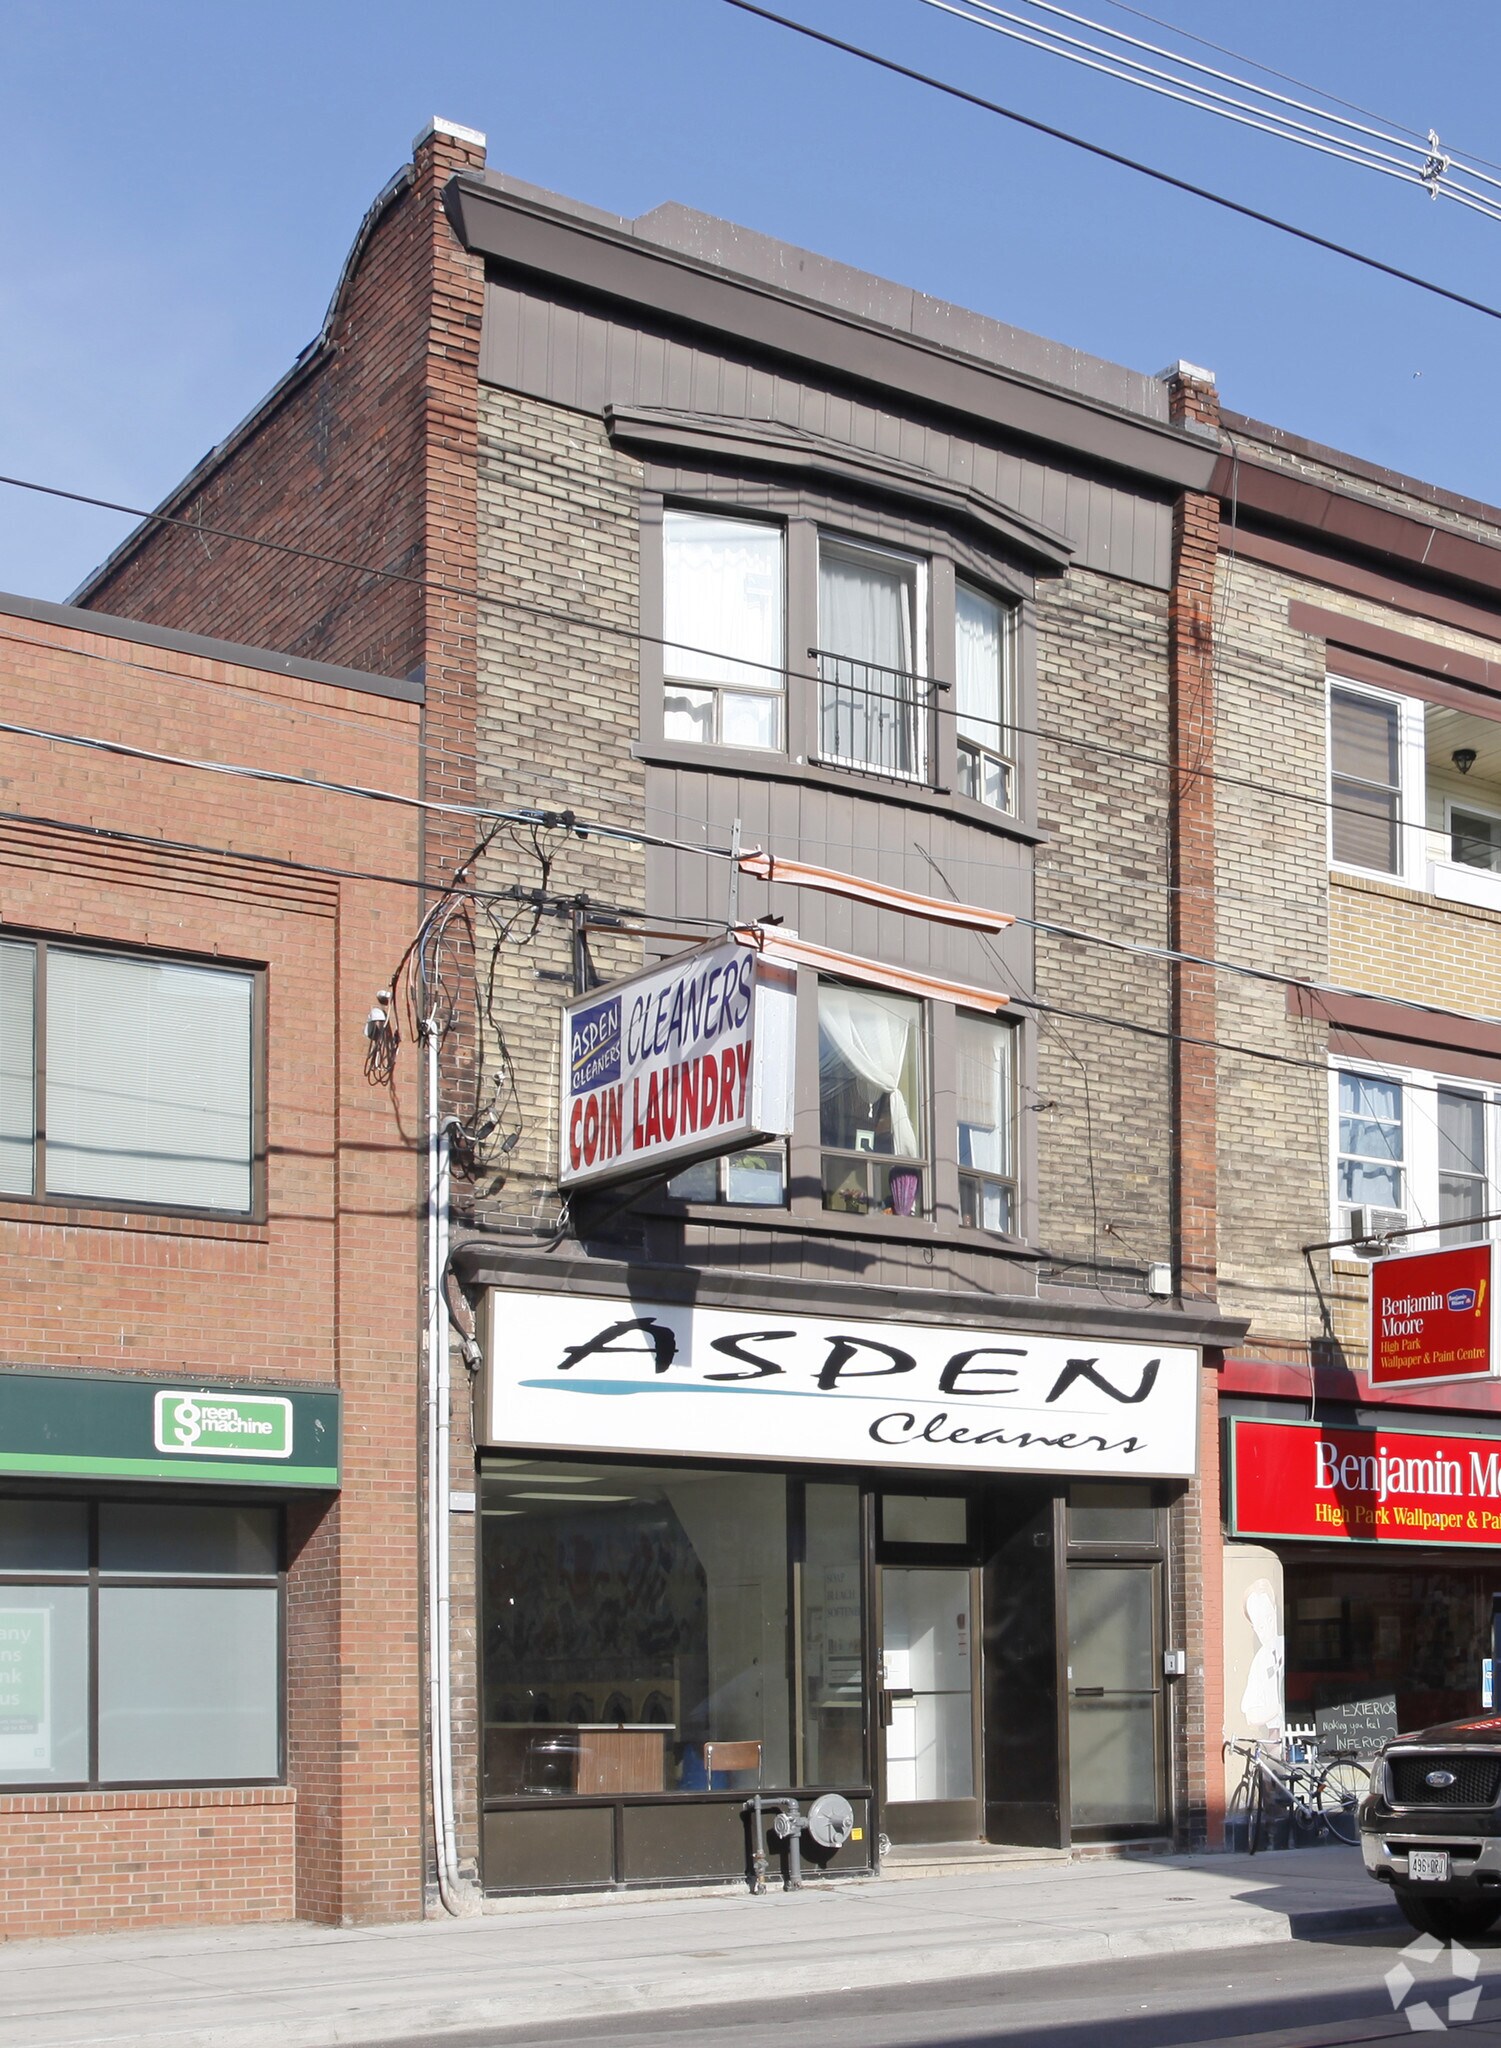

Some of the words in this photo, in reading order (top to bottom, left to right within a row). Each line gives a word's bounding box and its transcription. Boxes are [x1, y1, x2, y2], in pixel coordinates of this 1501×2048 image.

[627, 953, 753, 1065] CLEANERS
[572, 1004, 619, 1061] ASPEN
[572, 1040, 621, 1089] CLEANERS
[570, 1083, 623, 1171] COIN
[632, 1040, 752, 1150] LAUNDRY
[1382, 1291, 1443, 1318] Benjamin
[1381, 1317, 1424, 1338] Moore
[557, 1317, 1160, 1404] ASPEN
[1380, 1355, 1422, 1369] Wallpaper
[1423, 1352, 1431, 1364] &
[1433, 1350, 1455, 1364] Paint
[1456, 1347, 1486, 1361] Centre
[1381, 1340, 1400, 1354] High
[1401, 1337, 1421, 1350] Park
[201, 1418, 273, 1435] machine
[868, 1411, 1149, 1453] Cleaners
[1314, 1441, 1463, 1502] Benjamin
[1315, 1503, 1350, 1527] High
[1354, 1505, 1389, 1525] Park
[1393, 1506, 1463, 1530] Wallpaper
[1466, 1511, 1479, 1529] &
[1342, 1701, 1397, 1717] EXTERIOR
